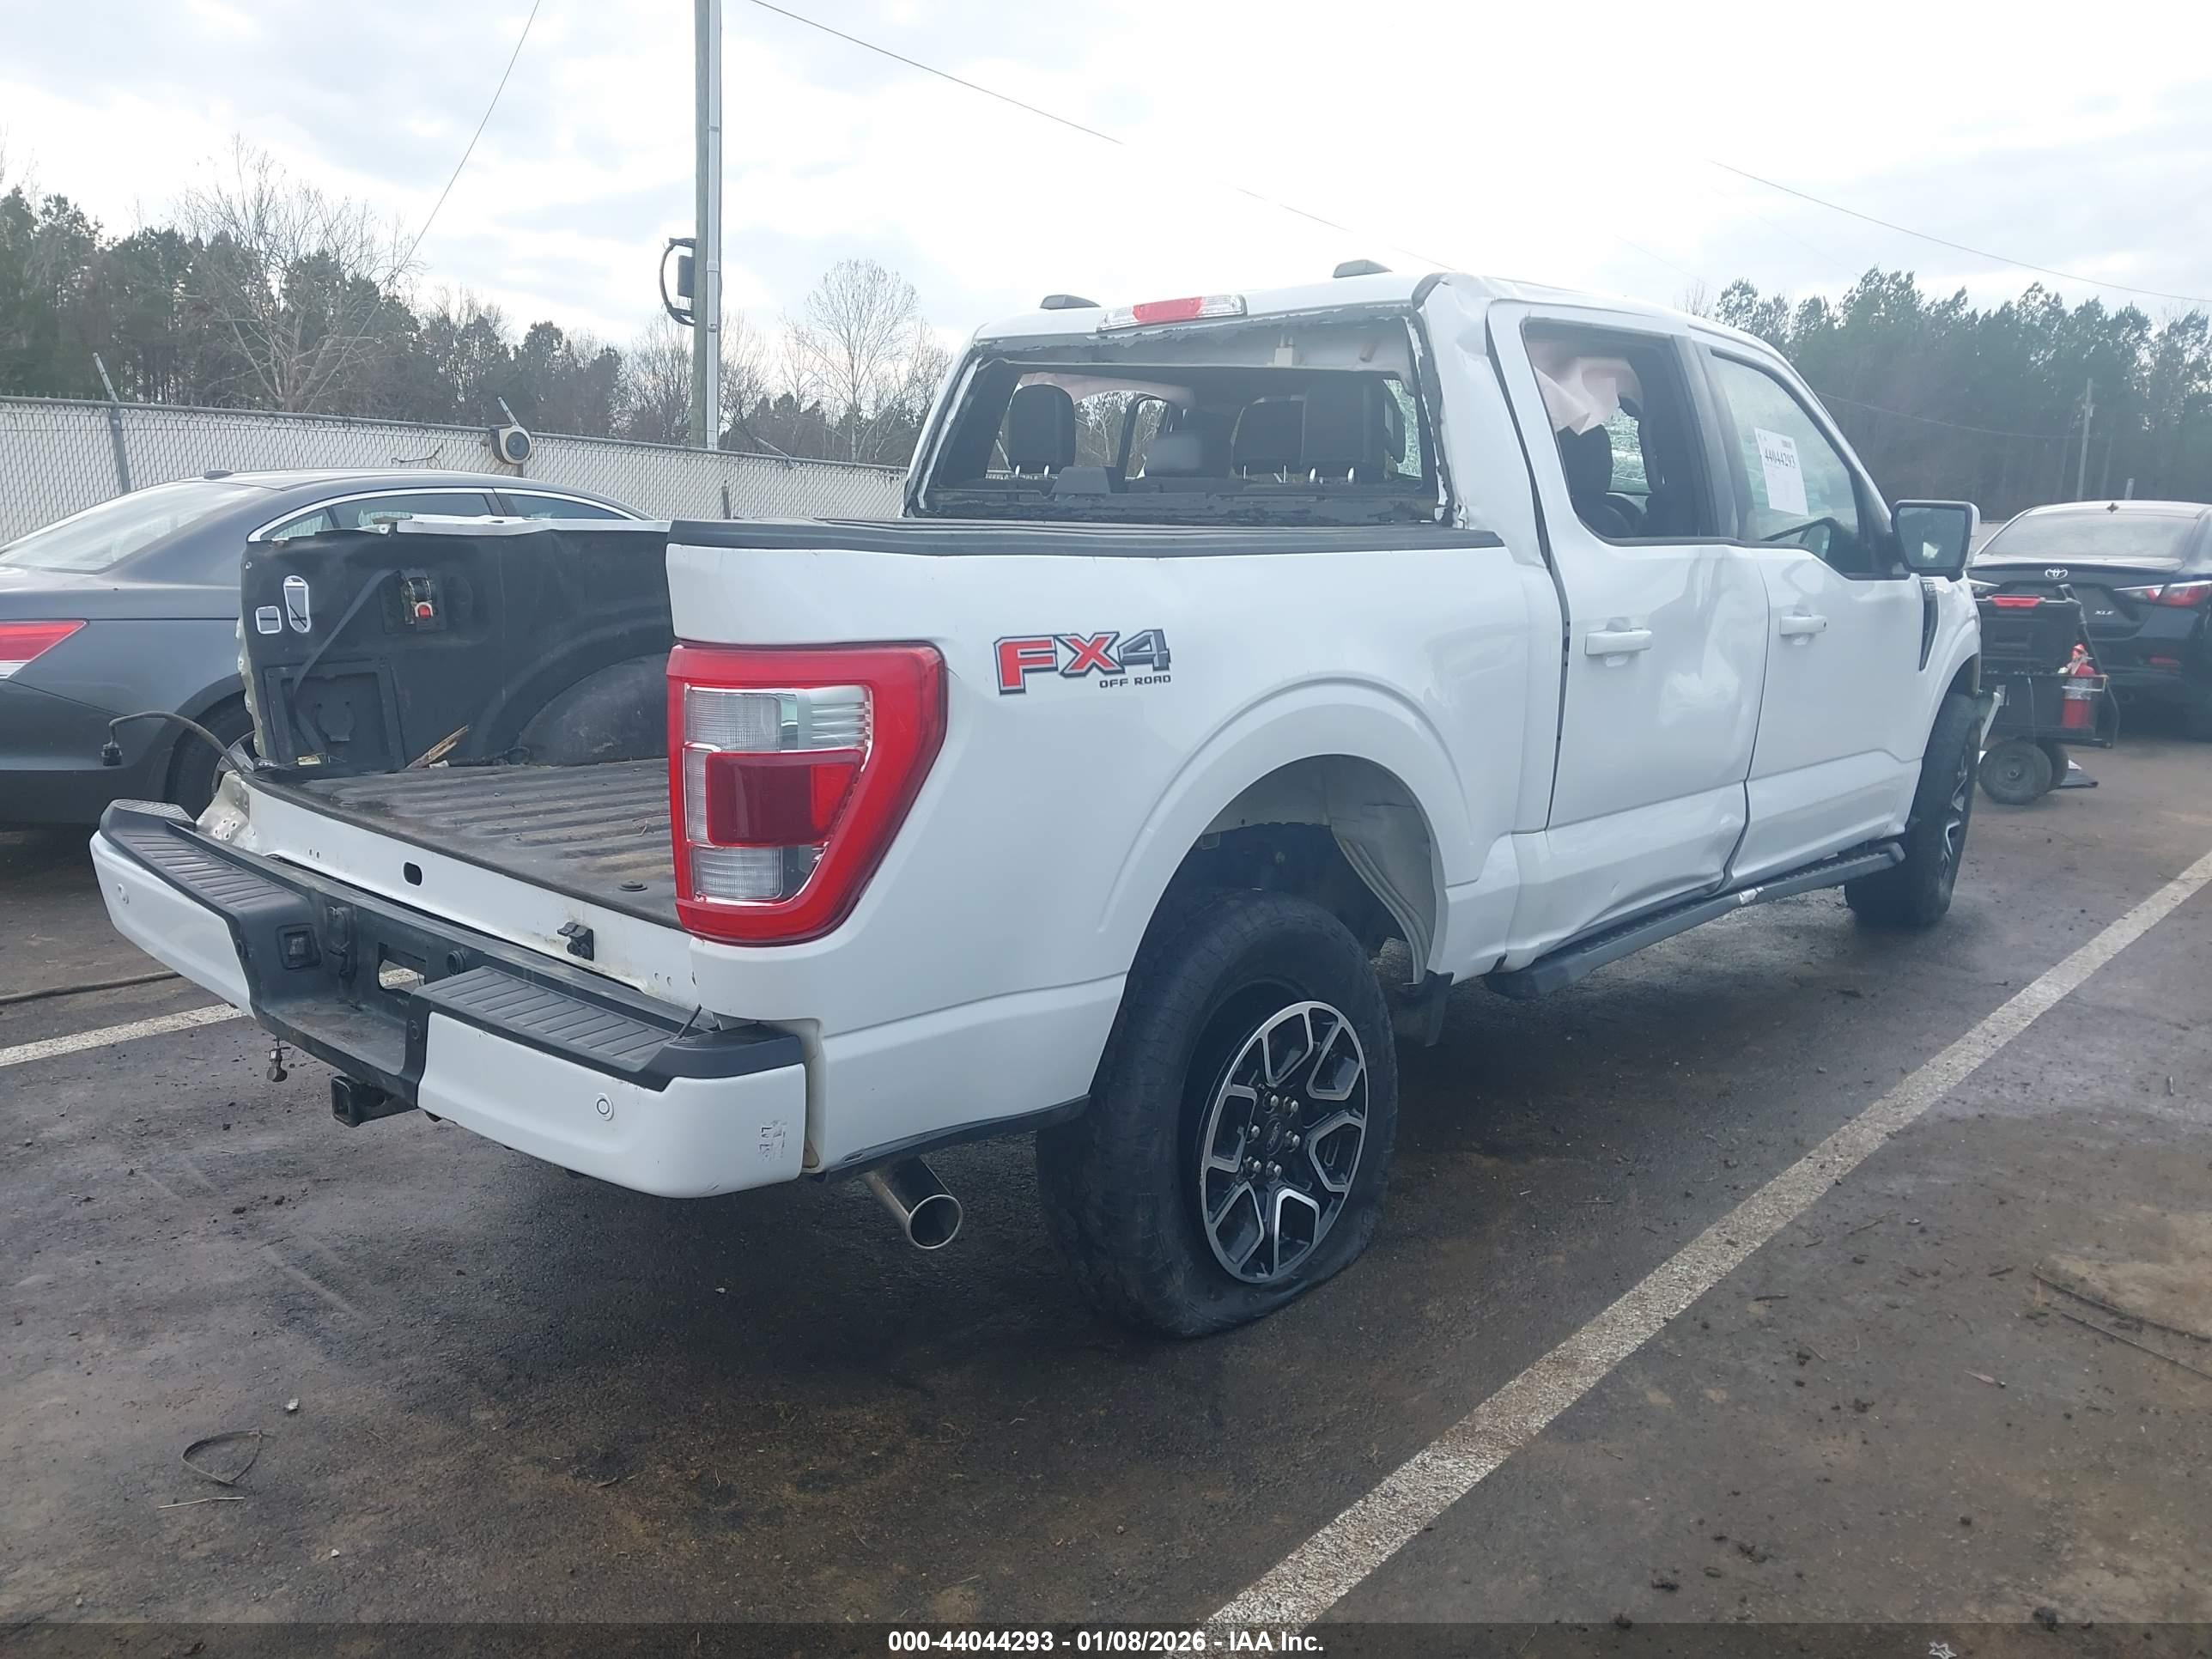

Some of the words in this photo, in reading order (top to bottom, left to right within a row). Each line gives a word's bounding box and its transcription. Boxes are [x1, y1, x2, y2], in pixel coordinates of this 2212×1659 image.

[994, 629, 1171, 695] FX4
[1099, 678, 1129, 689] OFF
[1133, 674, 1172, 686] ROAD
